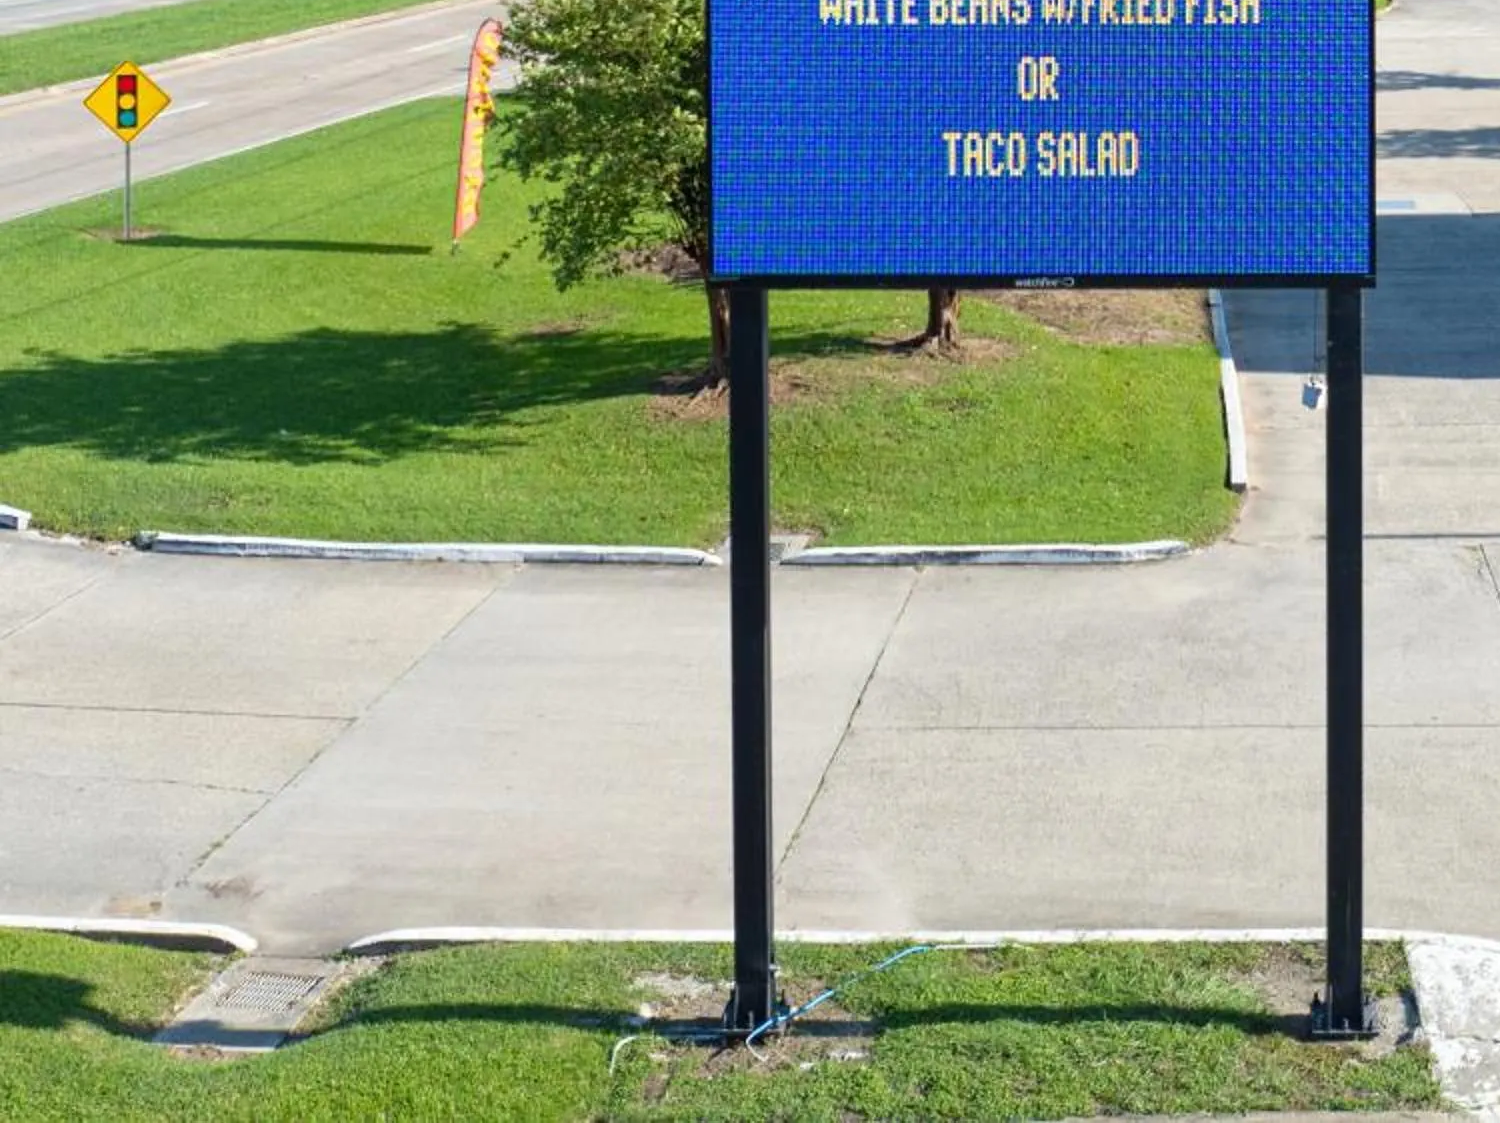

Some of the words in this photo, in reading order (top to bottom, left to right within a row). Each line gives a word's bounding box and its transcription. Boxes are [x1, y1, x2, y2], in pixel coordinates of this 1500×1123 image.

[1018, 56, 1059, 100] OR
[943, 132, 1026, 176] TACO
[1037, 132, 1140, 176] SALAD
